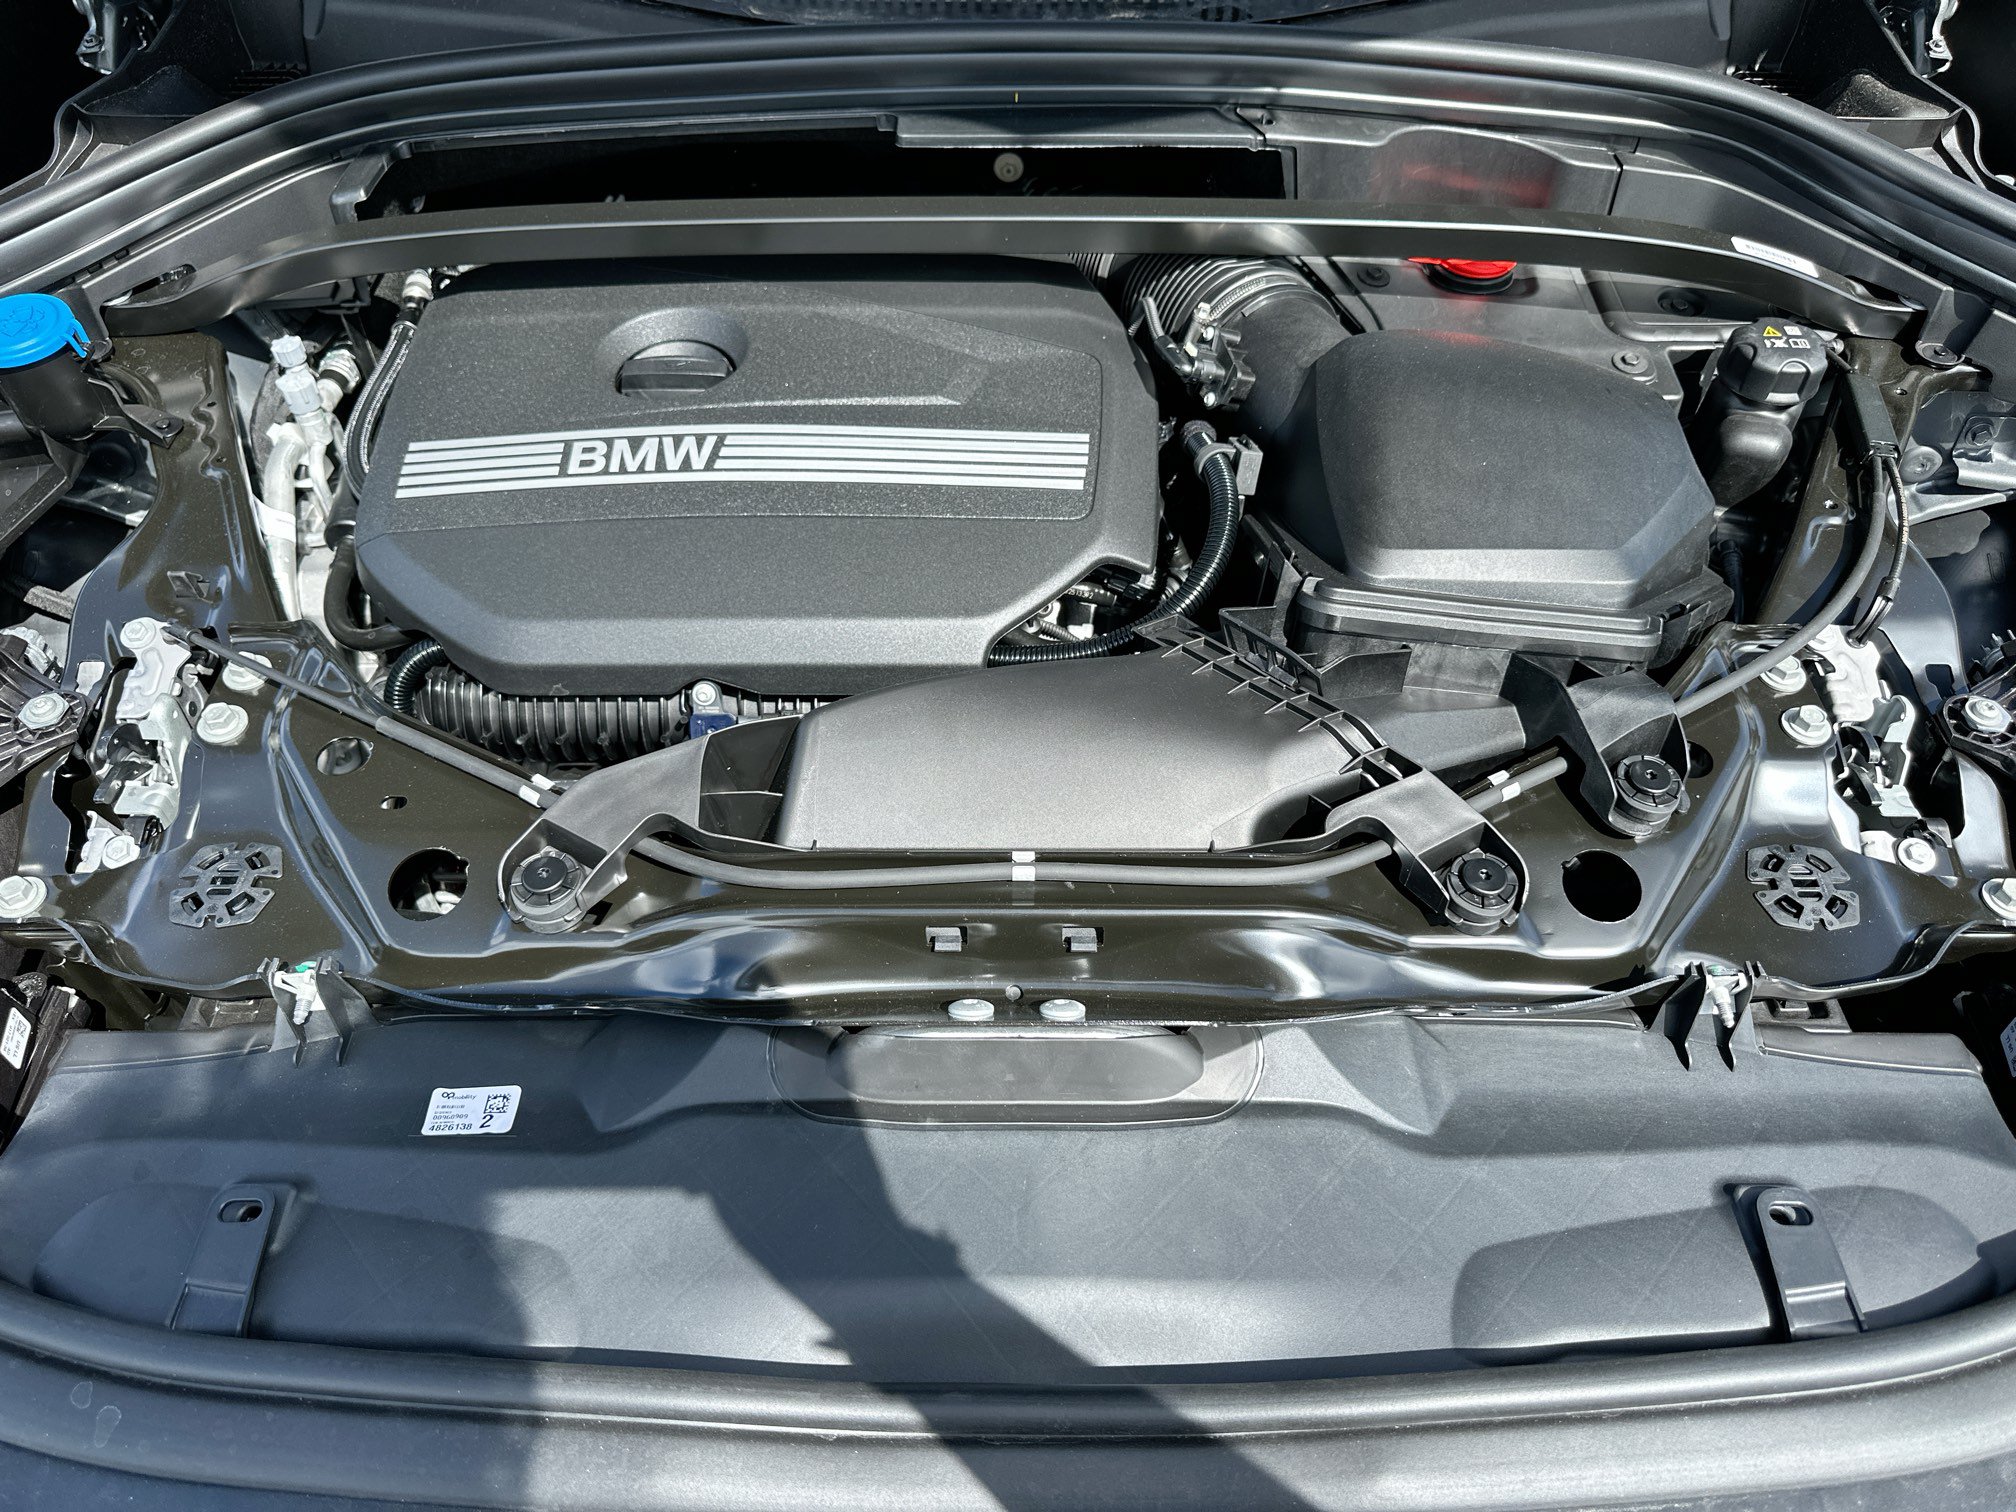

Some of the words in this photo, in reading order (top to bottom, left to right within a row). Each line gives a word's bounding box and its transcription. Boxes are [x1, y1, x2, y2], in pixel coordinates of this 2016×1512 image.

[567, 436, 718, 475] BMW
[428, 1123, 472, 1132] 4826138
[479, 1114, 494, 1129] 2
